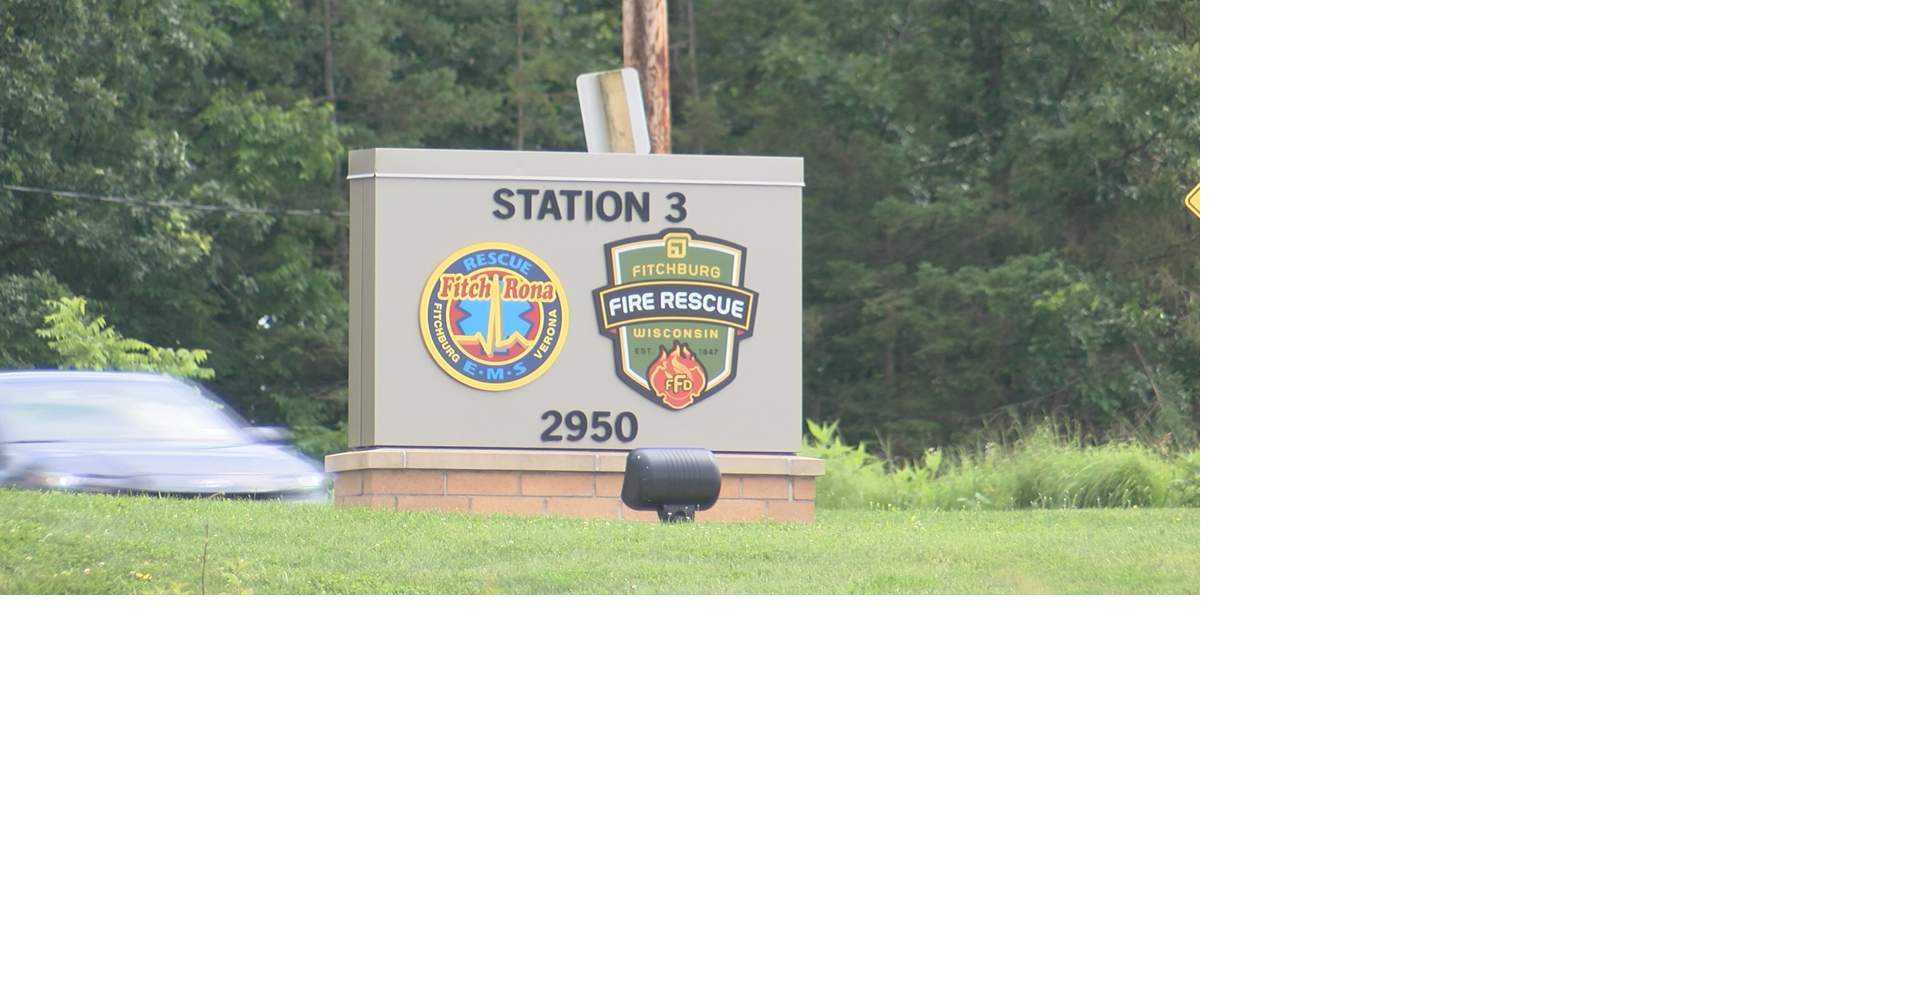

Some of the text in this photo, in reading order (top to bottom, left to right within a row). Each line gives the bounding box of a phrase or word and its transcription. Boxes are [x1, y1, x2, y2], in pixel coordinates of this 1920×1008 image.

[492, 188, 688, 223] STATION 3
[463, 252, 533, 276] RESCUE
[632, 263, 721, 278] FITCHBURG
[440, 276, 554, 300] Fitch Rona
[609, 291, 745, 319] FIRE RESCUE
[432, 302, 461, 364] FITCHBURG
[533, 309, 557, 360] VERONA
[633, 328, 719, 339] WISCONSIN
[665, 374, 693, 393] FFD
[540, 410, 639, 443] 2950
